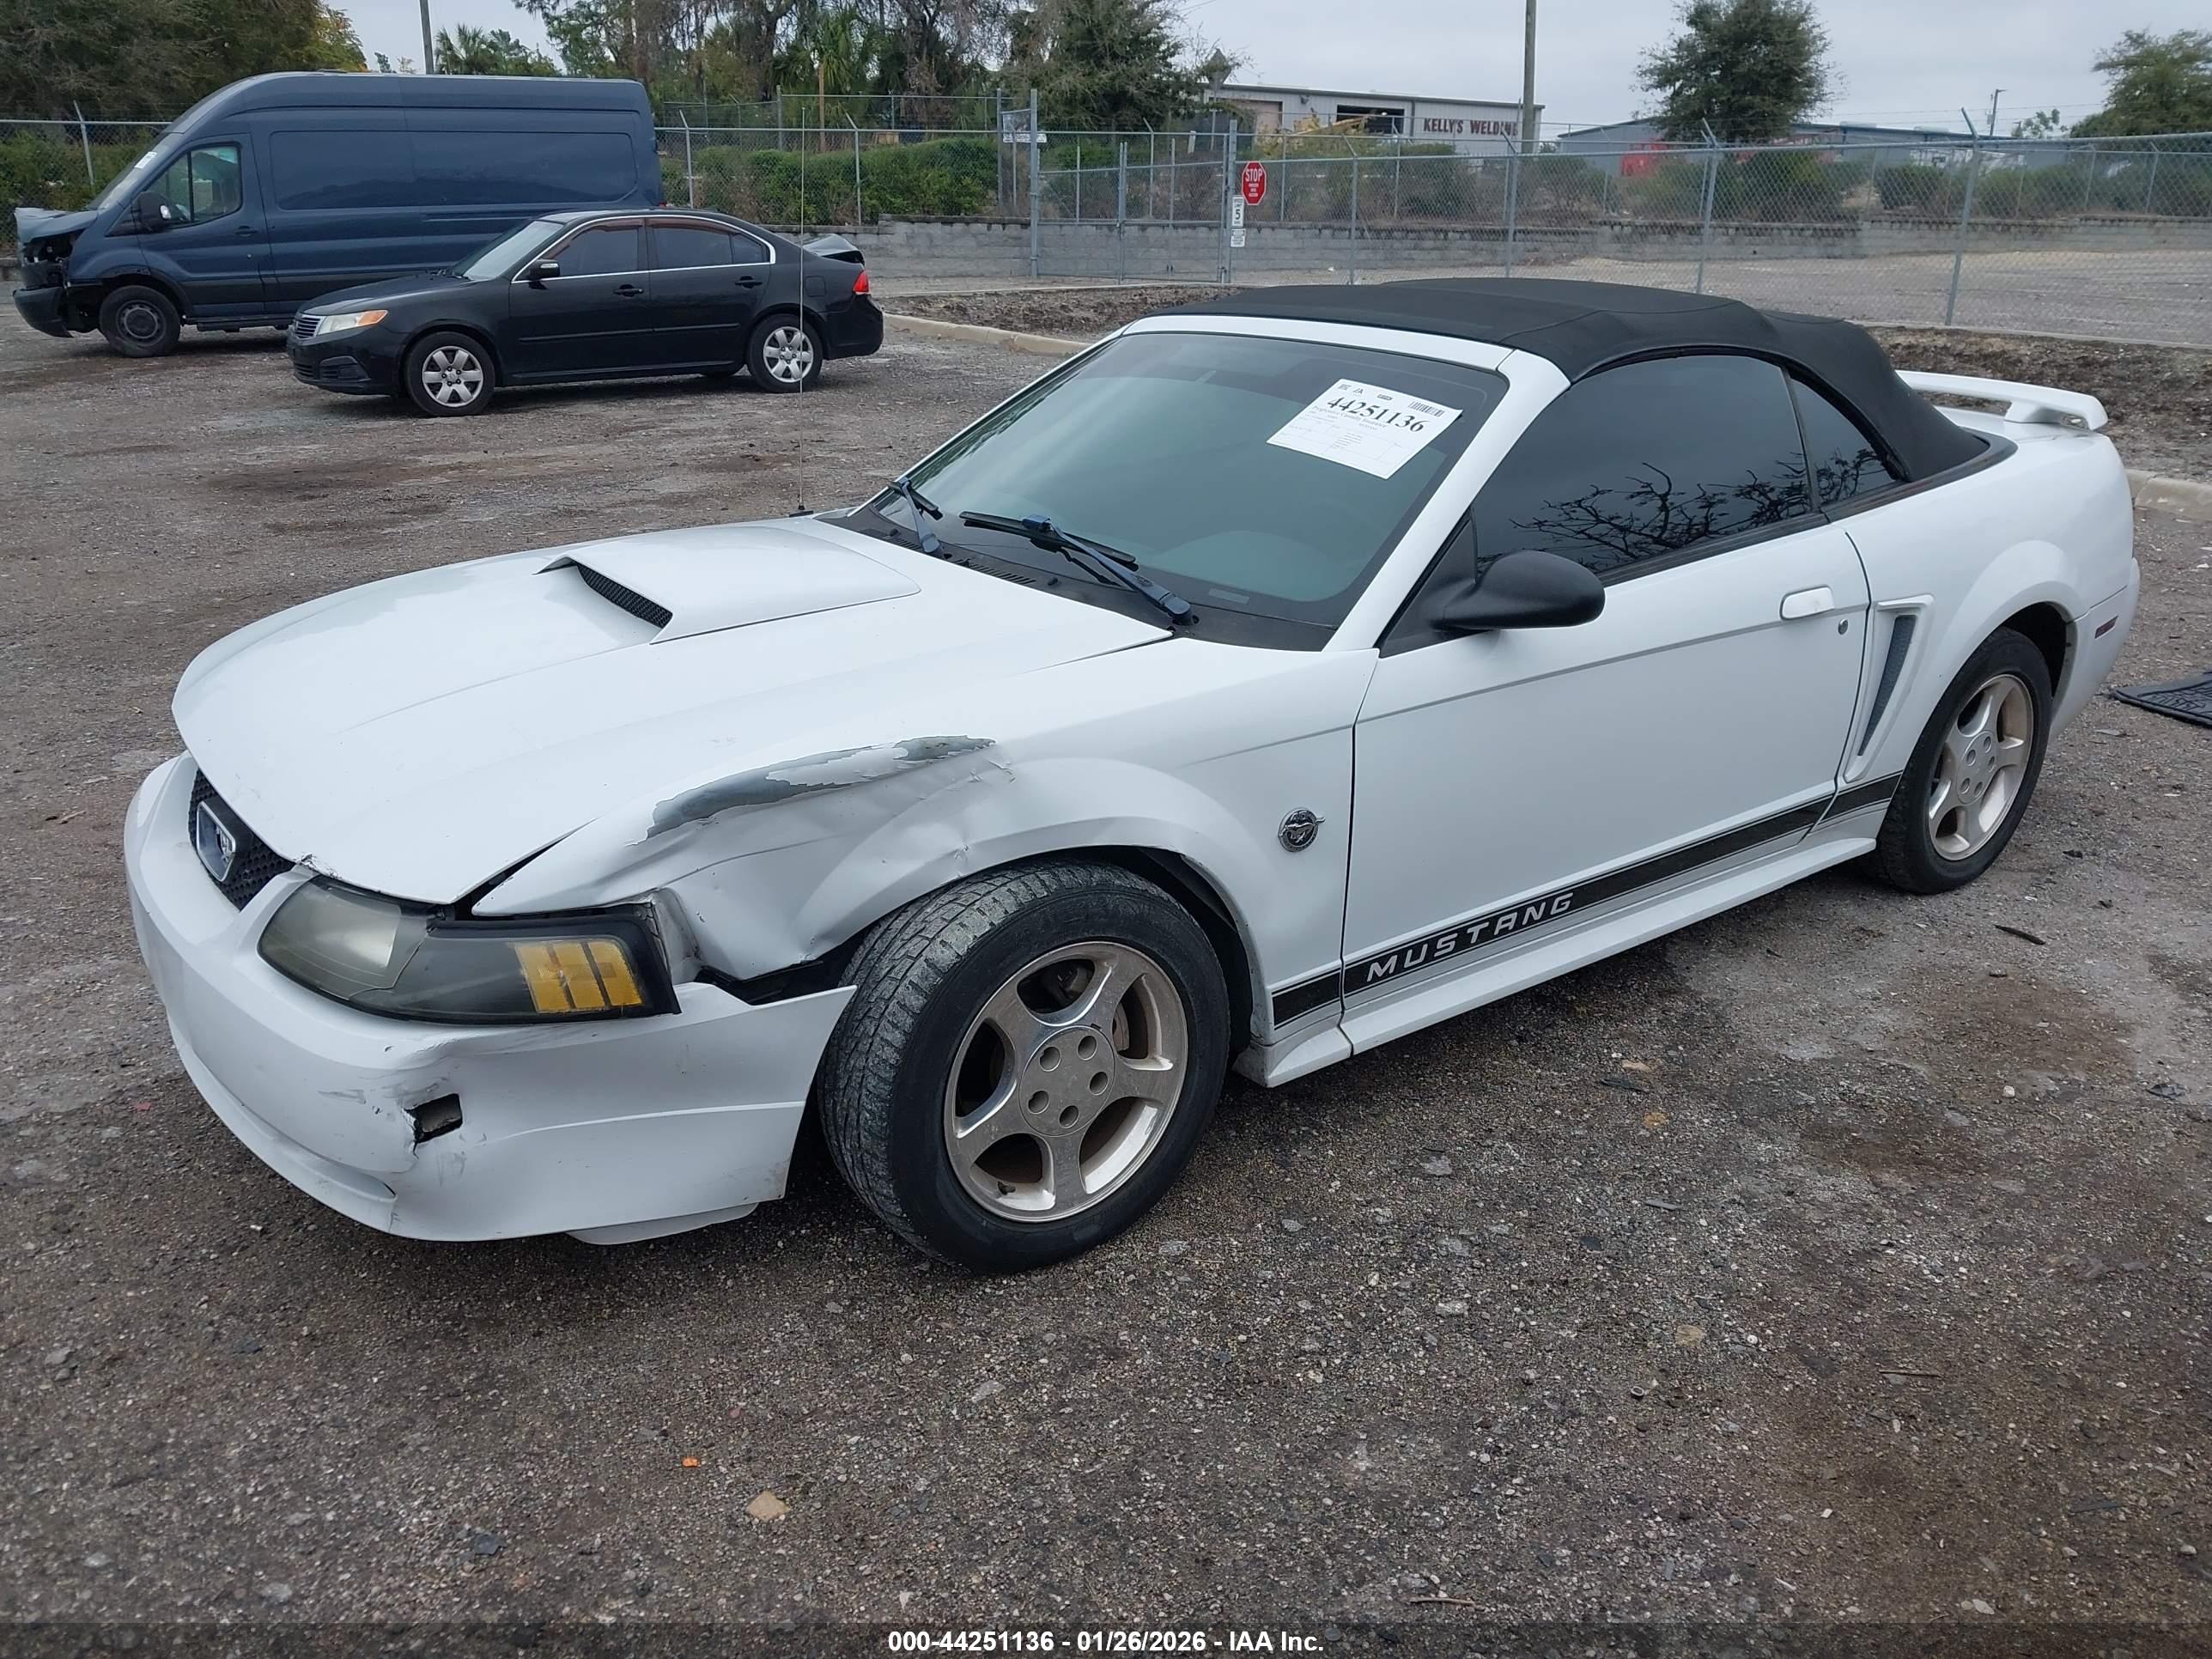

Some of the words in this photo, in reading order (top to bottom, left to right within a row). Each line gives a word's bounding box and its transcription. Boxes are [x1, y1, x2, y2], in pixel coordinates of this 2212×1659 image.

[1424, 118, 1463, 134] KELLY'S
[1470, 119, 1518, 136] WELDING
[1245, 168, 1262, 182] STOP
[1235, 209, 1241, 220] 5
[1327, 397, 1429, 433] 44251136
[1367, 892, 1573, 981] MUSTANG
